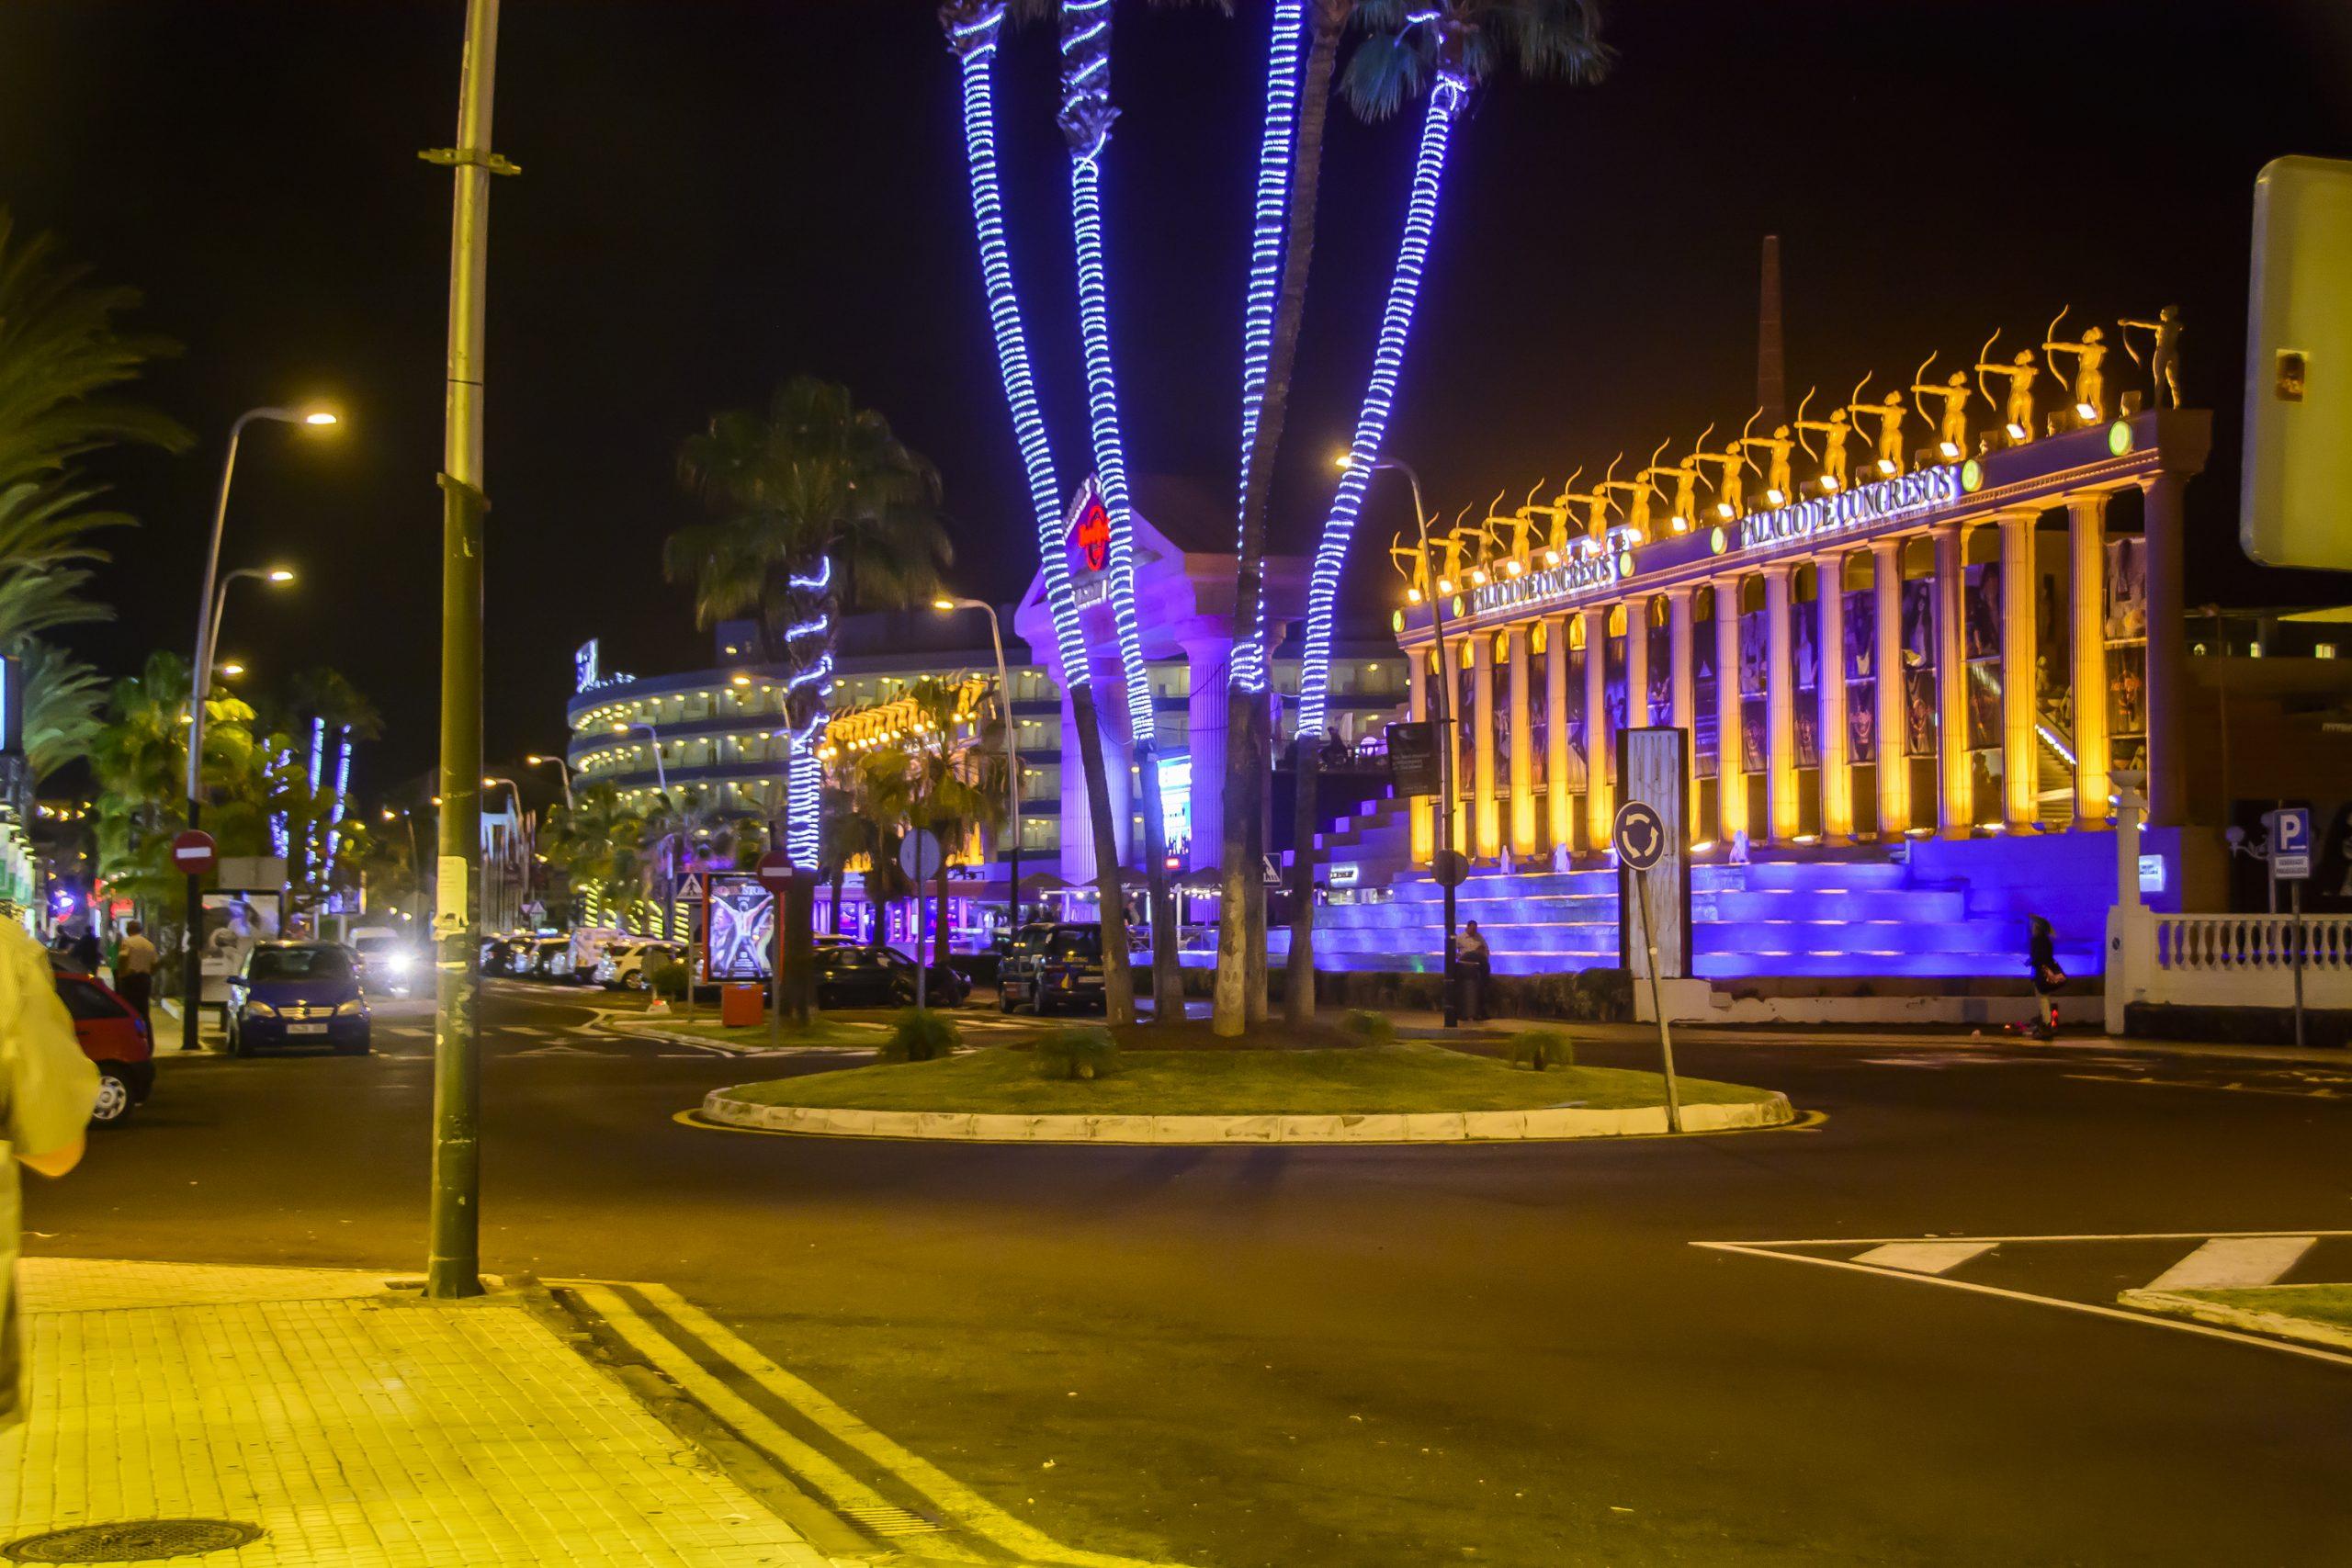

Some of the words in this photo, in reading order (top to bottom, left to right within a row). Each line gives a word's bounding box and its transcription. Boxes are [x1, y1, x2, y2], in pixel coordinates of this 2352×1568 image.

[1741, 504, 1808, 547] PALACIO
[1810, 499, 1835, 530] DE
[1838, 468, 1953, 525] CONGRESOS
[2280, 814, 2301, 851] P
